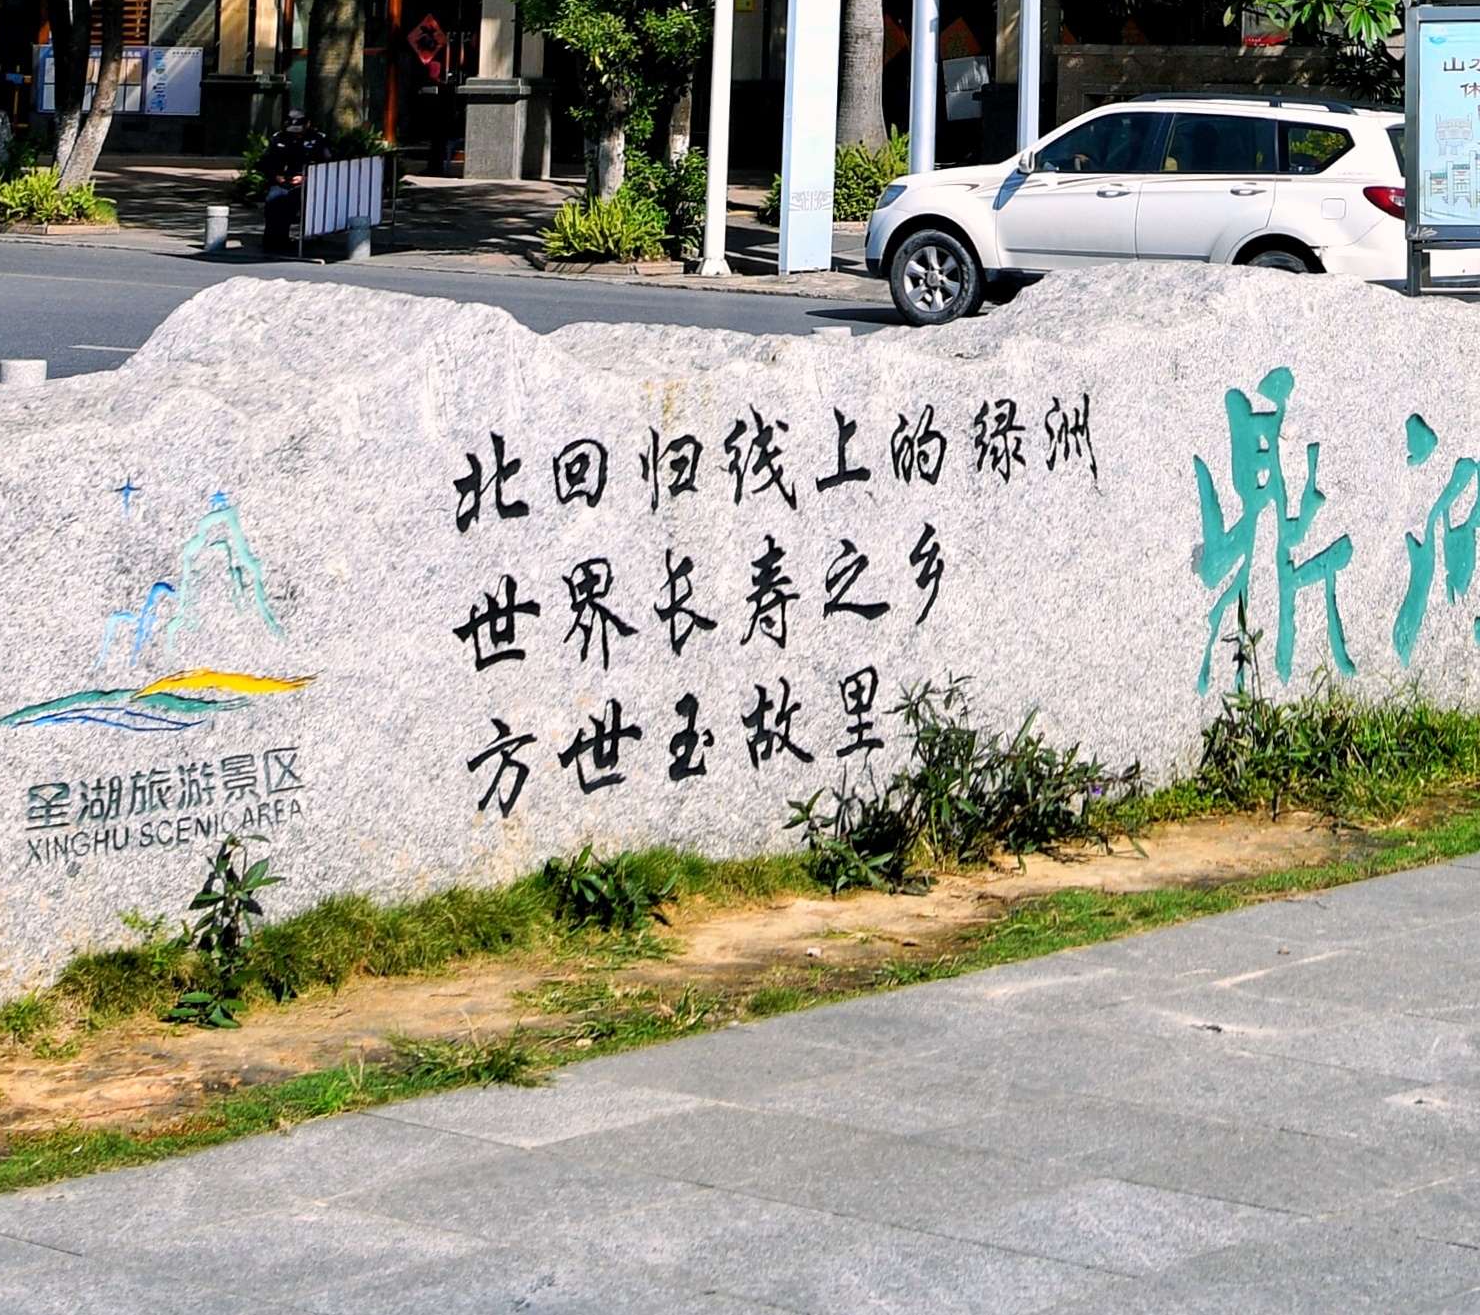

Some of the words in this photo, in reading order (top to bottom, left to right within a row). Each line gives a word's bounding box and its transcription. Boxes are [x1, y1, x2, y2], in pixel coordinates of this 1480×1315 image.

[455, 393, 1098, 533] 北回归线上的绿洲
[453, 523, 945, 670] 世界长寿之乡
[467, 666, 884, 817] 方世玉故里
[26, 827, 130, 868] XINGHU
[139, 811, 234, 848] SCENIC
[240, 799, 304, 833] AREA
